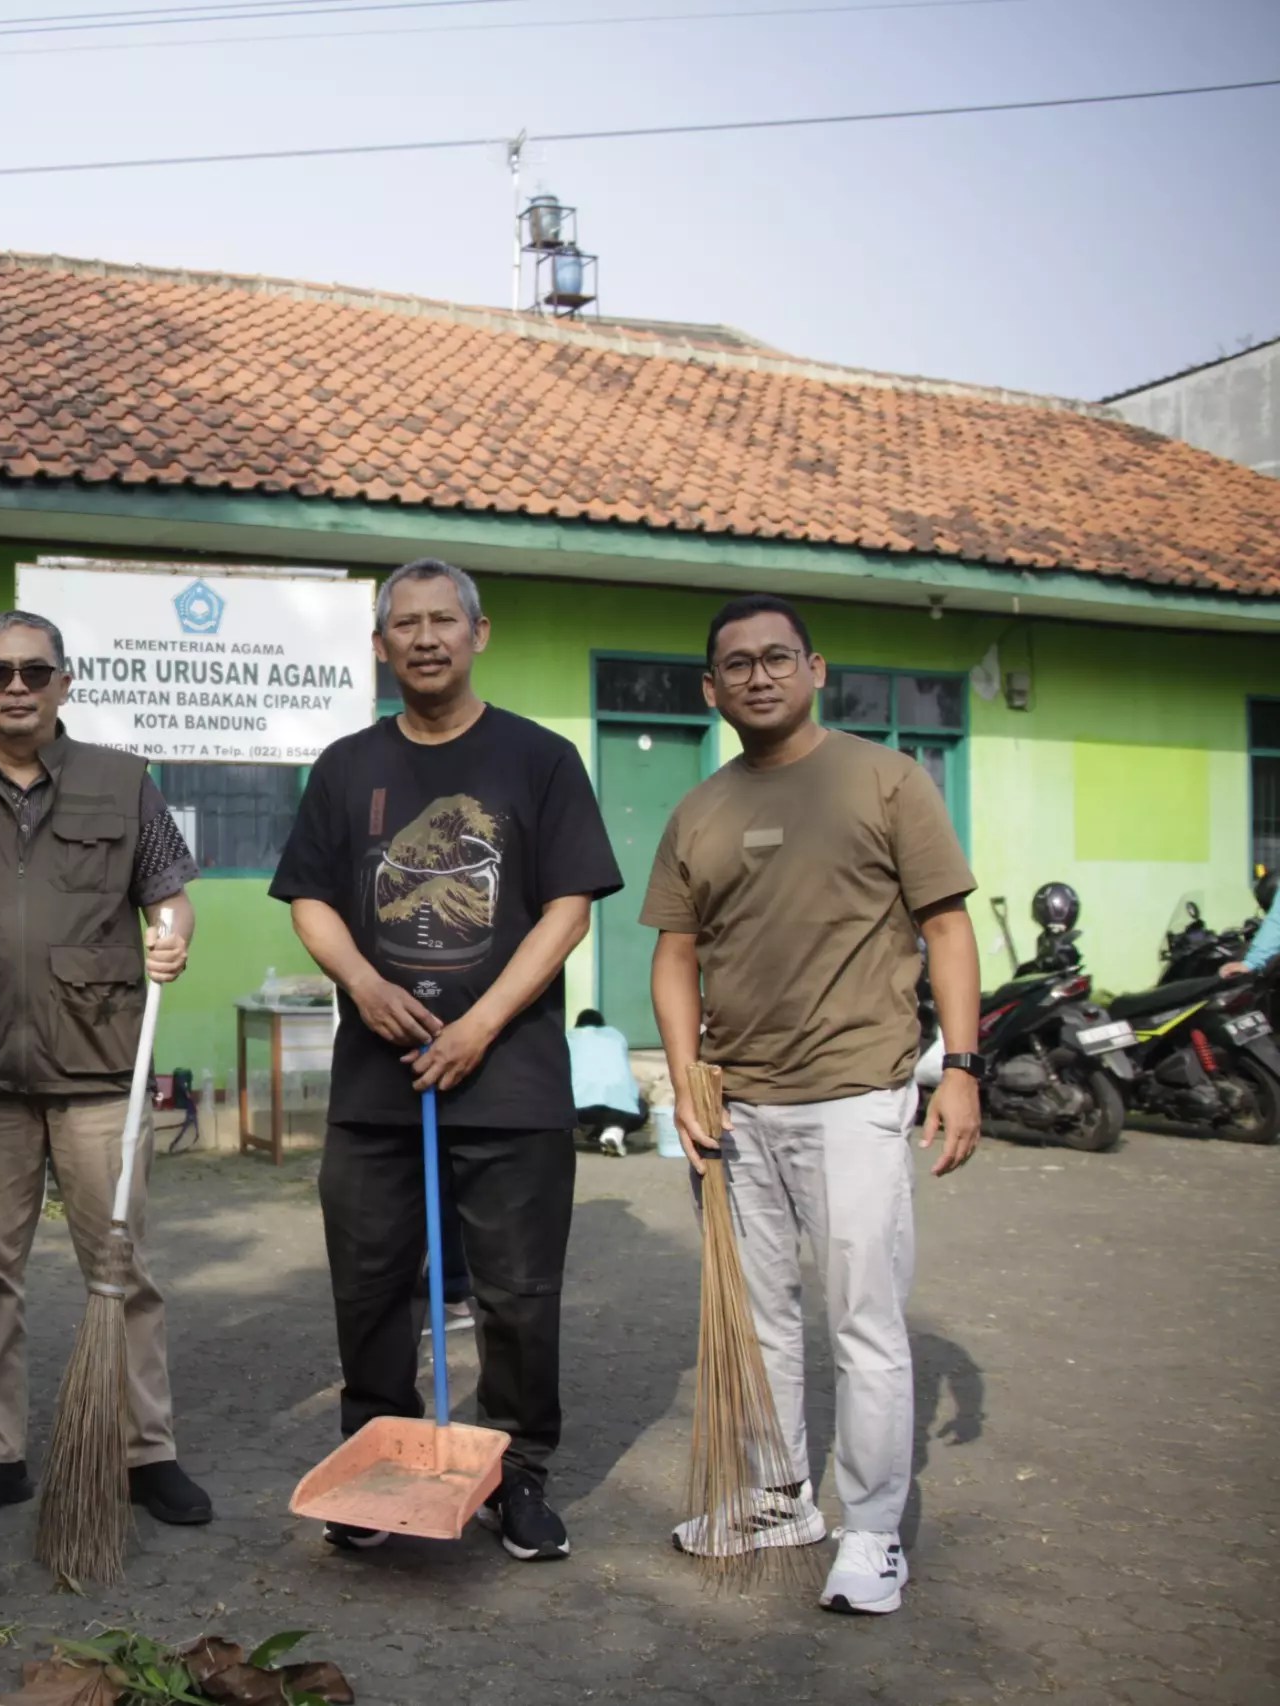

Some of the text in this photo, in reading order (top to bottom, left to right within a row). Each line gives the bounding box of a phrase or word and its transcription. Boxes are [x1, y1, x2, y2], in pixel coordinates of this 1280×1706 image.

[113, 639, 285, 656] KEMENTERIAN AGAMA
[63, 656, 354, 689] ANTOR URUSAN AGAMA
[177, 692, 257, 708] BABAKAN
[263, 694, 332, 709] CIPARAY
[134, 713, 268, 731] KOTA BANDUNG
[143, 743, 167, 755] NO.
[172, 745, 195, 755] 177
[200, 745, 209, 755] A
[249, 746, 281, 758] (022)
